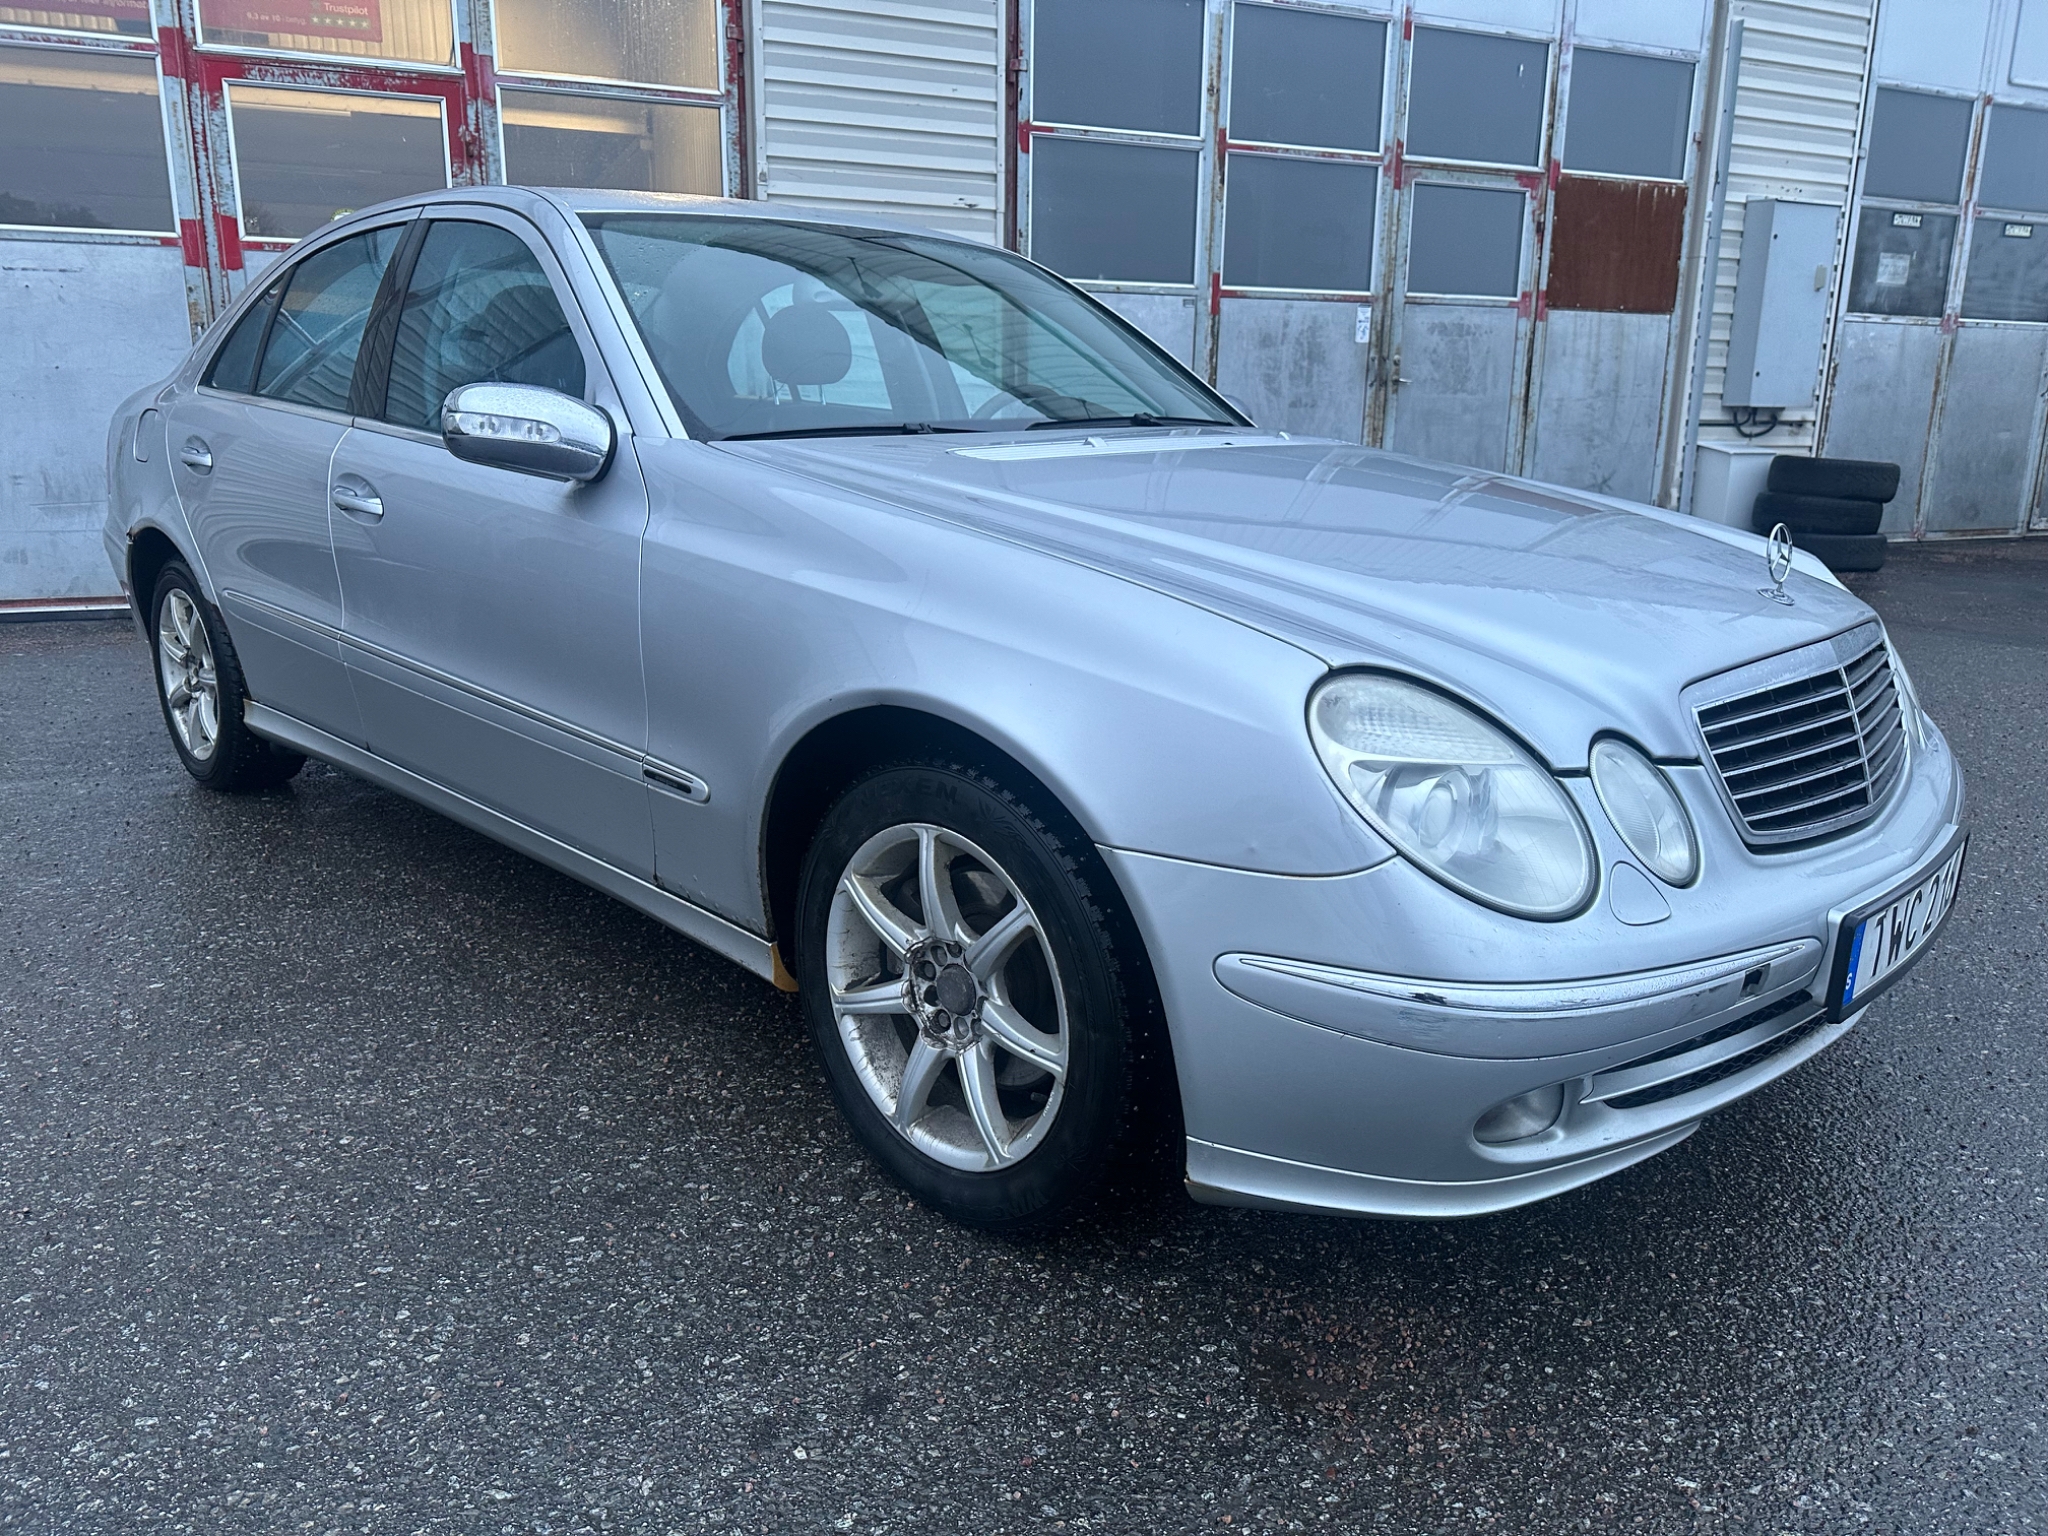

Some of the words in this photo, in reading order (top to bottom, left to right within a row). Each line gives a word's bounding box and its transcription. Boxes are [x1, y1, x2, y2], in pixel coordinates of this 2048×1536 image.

[323, 2, 369, 16] Trustpilot
[1870, 889, 1923, 978] TWC
[1845, 972, 1853, 990] S
